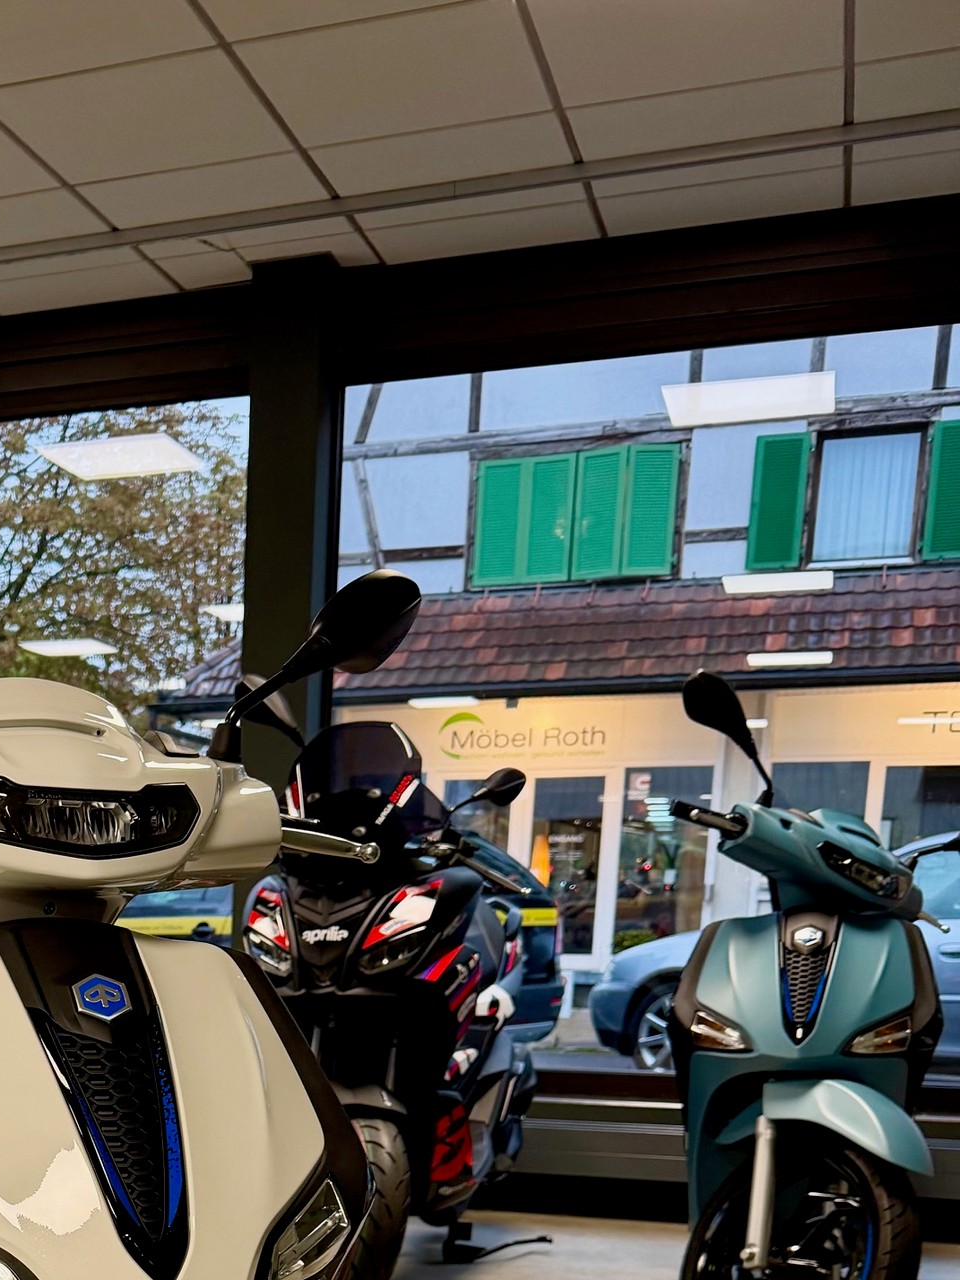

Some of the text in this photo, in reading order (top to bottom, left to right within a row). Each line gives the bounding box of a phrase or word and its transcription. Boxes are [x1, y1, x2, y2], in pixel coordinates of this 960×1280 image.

[451, 726, 606, 750] Möbel Roth
[301, 925, 349, 945] aprilia
